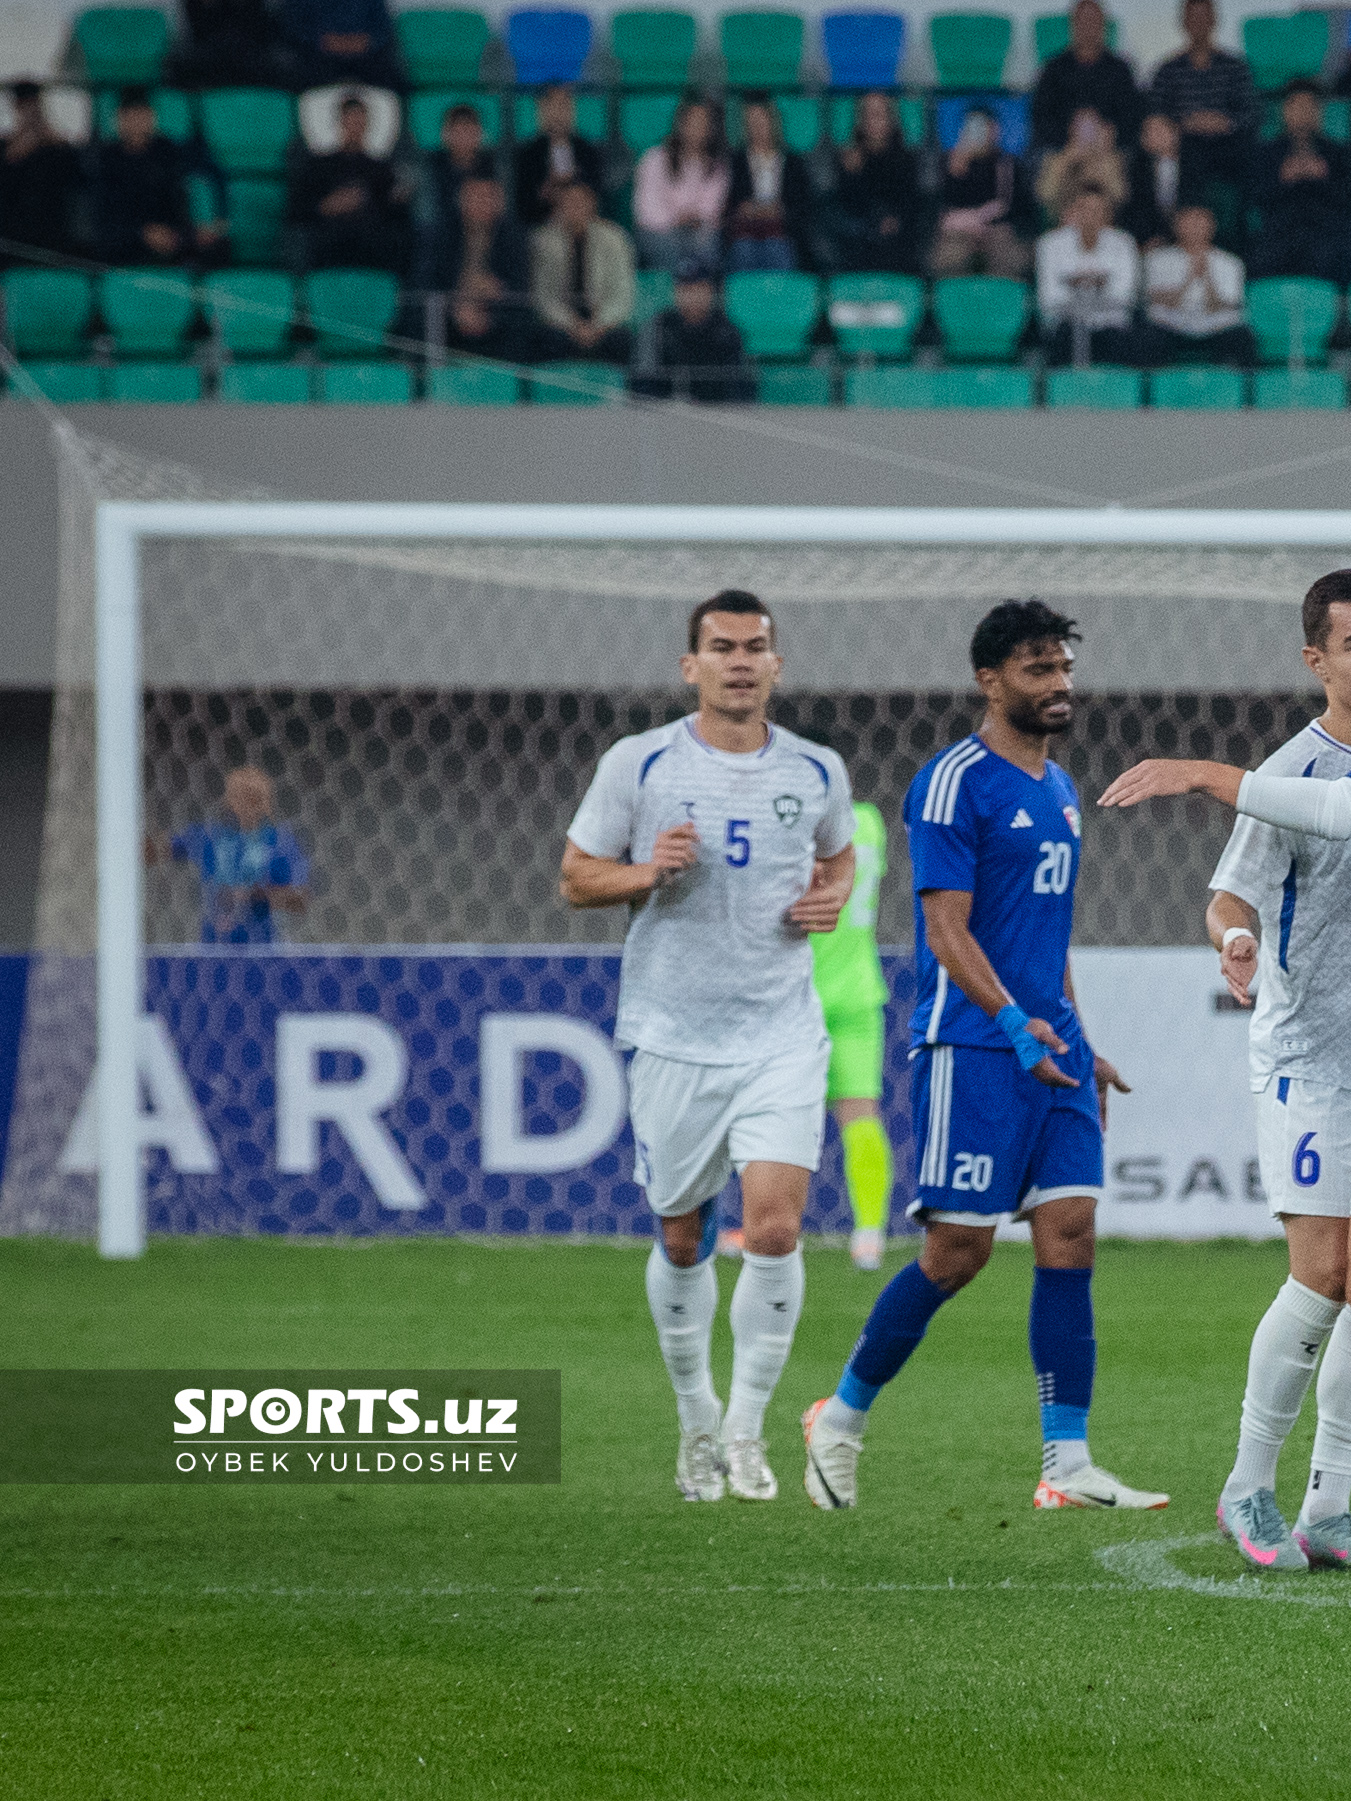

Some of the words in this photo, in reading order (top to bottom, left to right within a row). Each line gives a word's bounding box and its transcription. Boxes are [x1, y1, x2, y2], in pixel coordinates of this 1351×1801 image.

[725, 820, 750, 867] 5
[1033, 841, 1072, 895] 20
[952, 1153, 994, 1193] 20
[1292, 1131, 1322, 1188] 6
